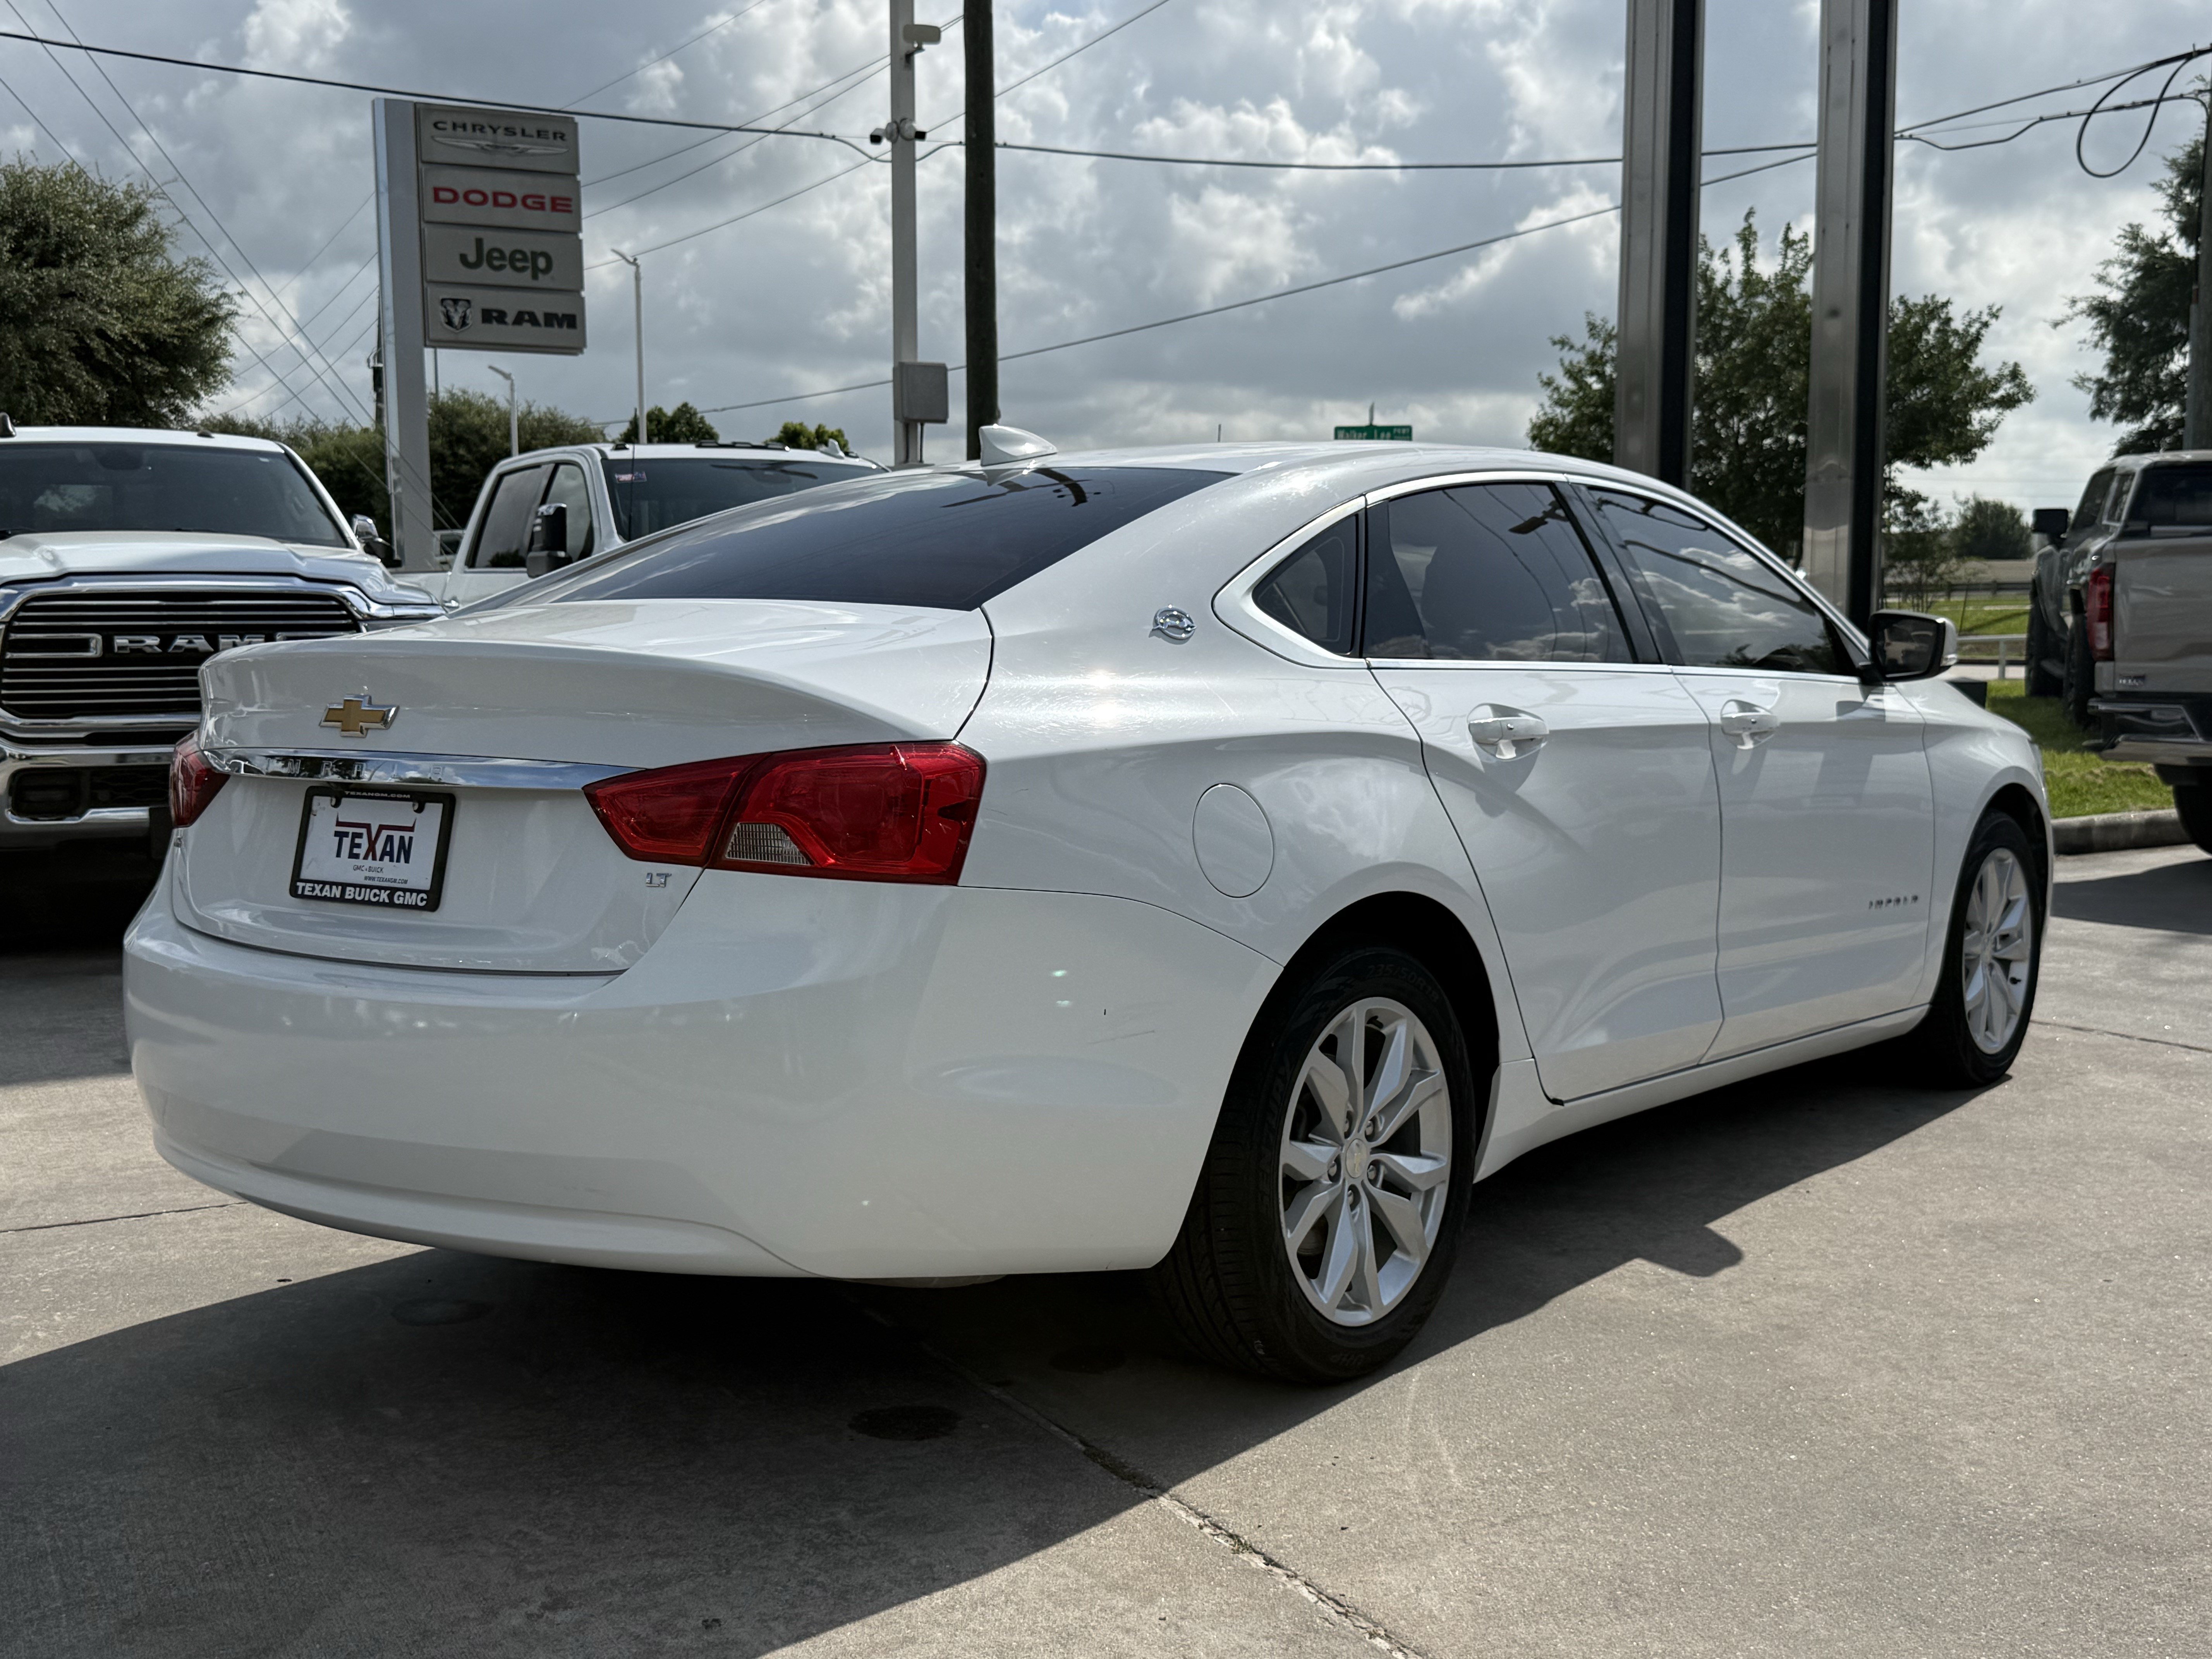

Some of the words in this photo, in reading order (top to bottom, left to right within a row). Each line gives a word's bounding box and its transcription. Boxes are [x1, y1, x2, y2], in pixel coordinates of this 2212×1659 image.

[433, 120, 567, 141] CHRYSLER
[433, 187, 573, 213] DODGE
[459, 237, 553, 280] Jeep
[481, 308, 577, 330] RAM
[114, 634, 265, 653] RAM
[333, 821, 415, 864] TEXAN
[645, 872, 672, 887] LT
[296, 882, 342, 898] TEXAN
[344, 886, 389, 903] BUICK
[393, 891, 427, 907] GMC
[1869, 895, 1919, 910] IMPALA
